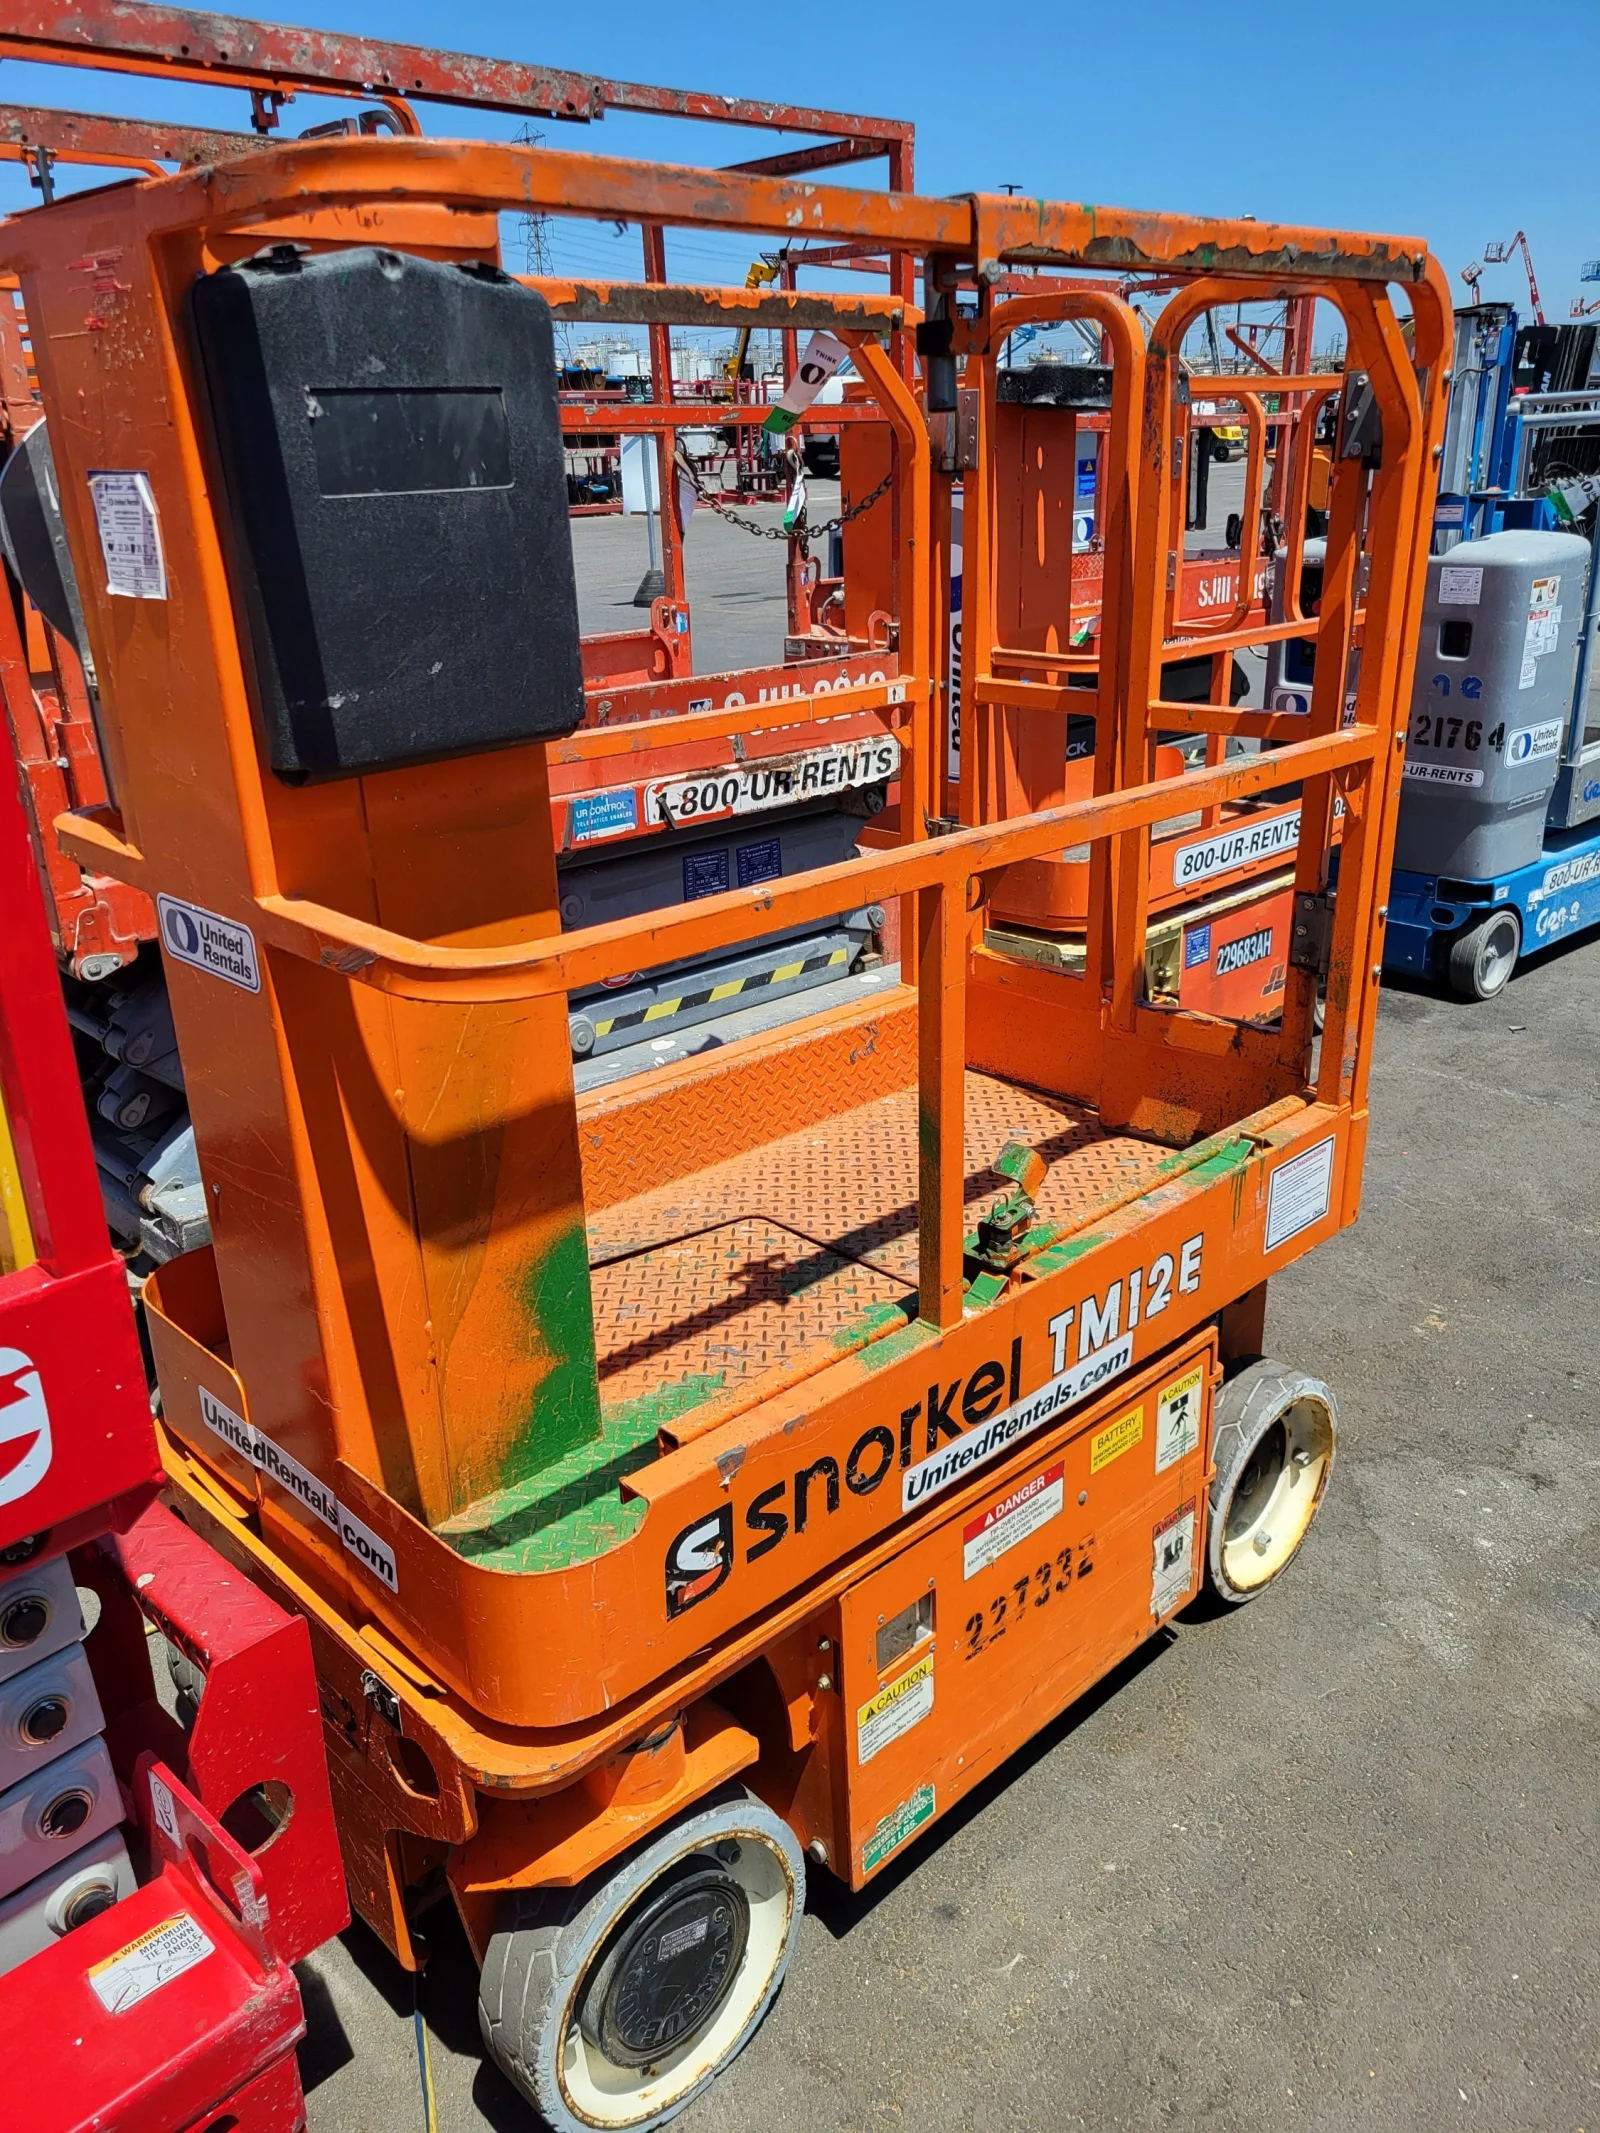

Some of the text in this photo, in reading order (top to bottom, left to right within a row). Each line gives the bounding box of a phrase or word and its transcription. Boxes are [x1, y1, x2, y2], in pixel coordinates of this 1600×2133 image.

[815, 349, 837, 365] THINK
[1531, 740, 1558, 756] Rentals
[1533, 726, 1558, 743] United
[656, 746, 893, 821] 1-800-UR-RENTS
[590, 801, 627, 816] CONTROL
[200, 920, 244, 956] United
[1216, 929, 1273, 976] 229683AH
[203, 942, 252, 980] Rentals
[746, 1232, 1204, 1564] snorkel TM12E
[1168, 1372, 1200, 1399] CAUTION
[907, 1346, 1130, 1501] UnitedRentals.com
[1097, 1413, 1137, 1450] BATTERY
[995, 1473, 1045, 1520] DANGER
[989, 1496, 1039, 1537] TIP-OVER HAZARD
[876, 1664, 927, 1711] CAUTION
[879, 1833, 896, 1856] 675
[120, 1923, 169, 1956] WARNING
[139, 1919, 190, 1956] MAXIMUM
[144, 1926, 195, 1961] TIE-DOWN
[167, 1932, 200, 1957] ANGLE
